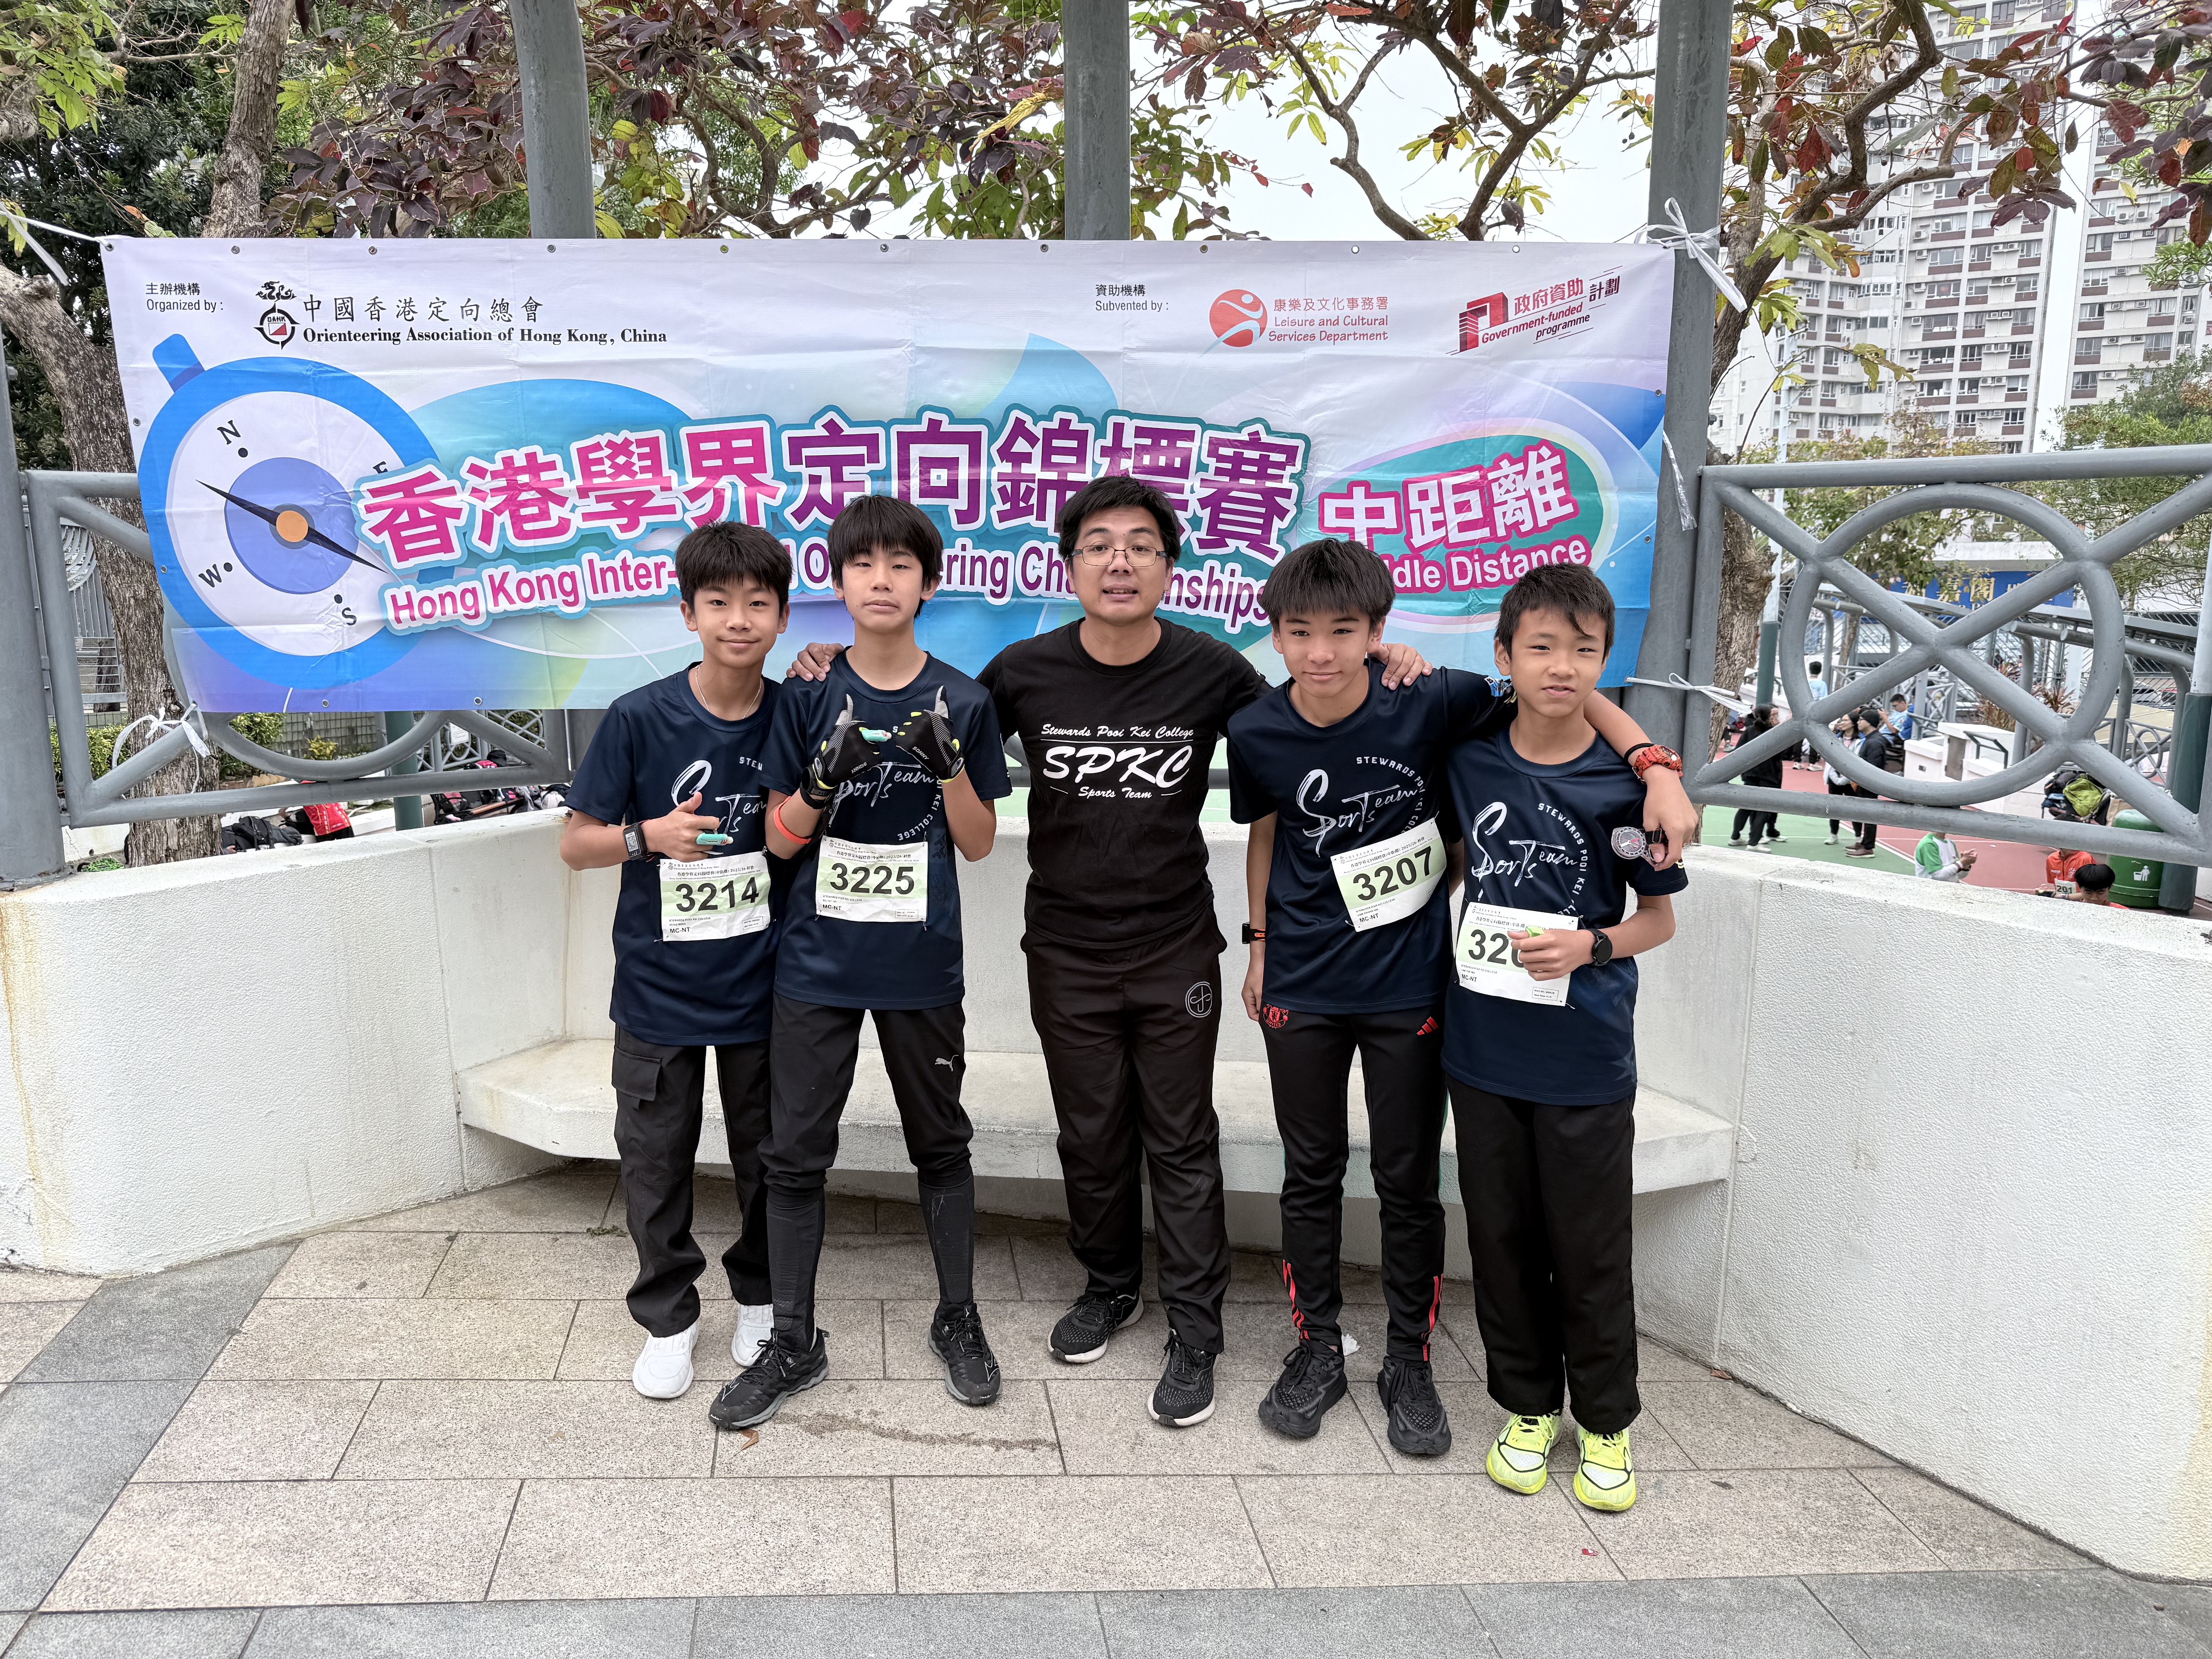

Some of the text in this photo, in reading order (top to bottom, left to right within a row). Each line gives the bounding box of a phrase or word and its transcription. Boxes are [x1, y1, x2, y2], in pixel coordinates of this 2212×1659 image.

[146, 282, 201, 296] 主辦機構
[1095, 284, 1146, 297] 資助機構
[1514, 276, 1620, 316] 政府資助 計劃
[147, 299, 200, 312] Organized
[204, 299, 216, 313] by
[303, 294, 543, 323] 中國香港定向總會
[1095, 300, 1147, 311] Subvented
[1151, 300, 1163, 313] by
[1274, 296, 1388, 312] 康樂及文化事務署
[1274, 315, 1388, 327] Leisure and Cultural
[1482, 301, 1583, 343] Government-funded
[1535, 314, 1590, 340] programme
[303, 326, 667, 345] Orienteering Association of Hong Kong, China
[1268, 330, 1388, 345] Services Department
[217, 420, 241, 445] N
[1323, 445, 1574, 549] 中距離
[198, 563, 222, 588] W
[1384, 540, 1587, 588] dle Distance
[390, 586, 480, 624] Hong
[488, 570, 578, 608] Kong
[342, 607, 357, 625] S
[1041, 723, 1194, 739] Stewards Pooi Kei College
[912, 746, 929, 760] SONNY
[1043, 745, 1192, 788] SPKC
[1356, 756, 1415, 777] STEWARDS
[931, 794, 941, 811] KEI
[1078, 786, 1152, 799] Sports Team
[897, 814, 933, 841] COLLEGE
[1538, 802, 1588, 895] STEWARDS POOI KEI
[829, 862, 915, 895] 3225
[1353, 846, 1432, 902] 3207
[675, 876, 759, 912] 3214
[1468, 929, 1524, 969] 32
